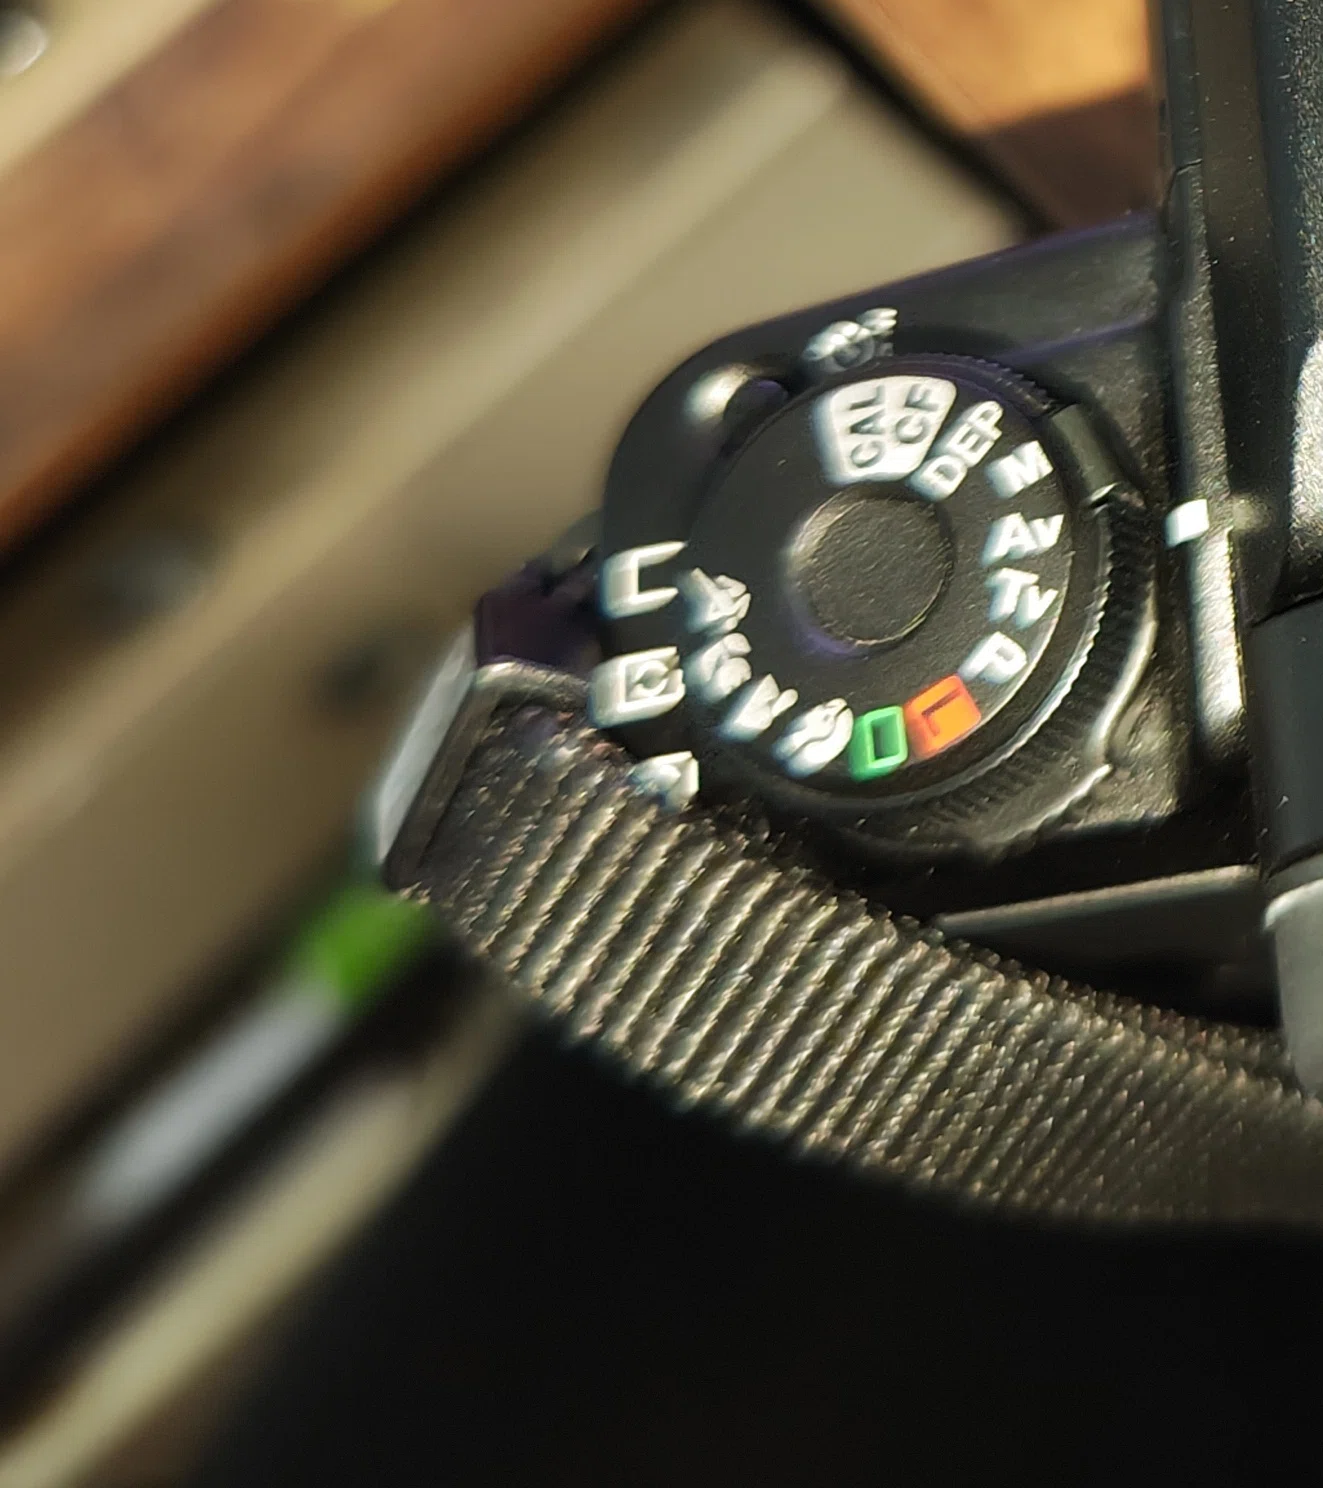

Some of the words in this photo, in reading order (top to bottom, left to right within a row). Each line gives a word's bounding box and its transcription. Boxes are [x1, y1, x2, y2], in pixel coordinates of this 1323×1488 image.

[849, 384, 886, 470] CAL
[895, 382, 940, 445] CF
[906, 401, 1004, 500] DEP
[987, 440, 1054, 499] M
[983, 512, 1065, 565] Av
[985, 568, 1059, 630] Tv
[958, 631, 1028, 684] P
